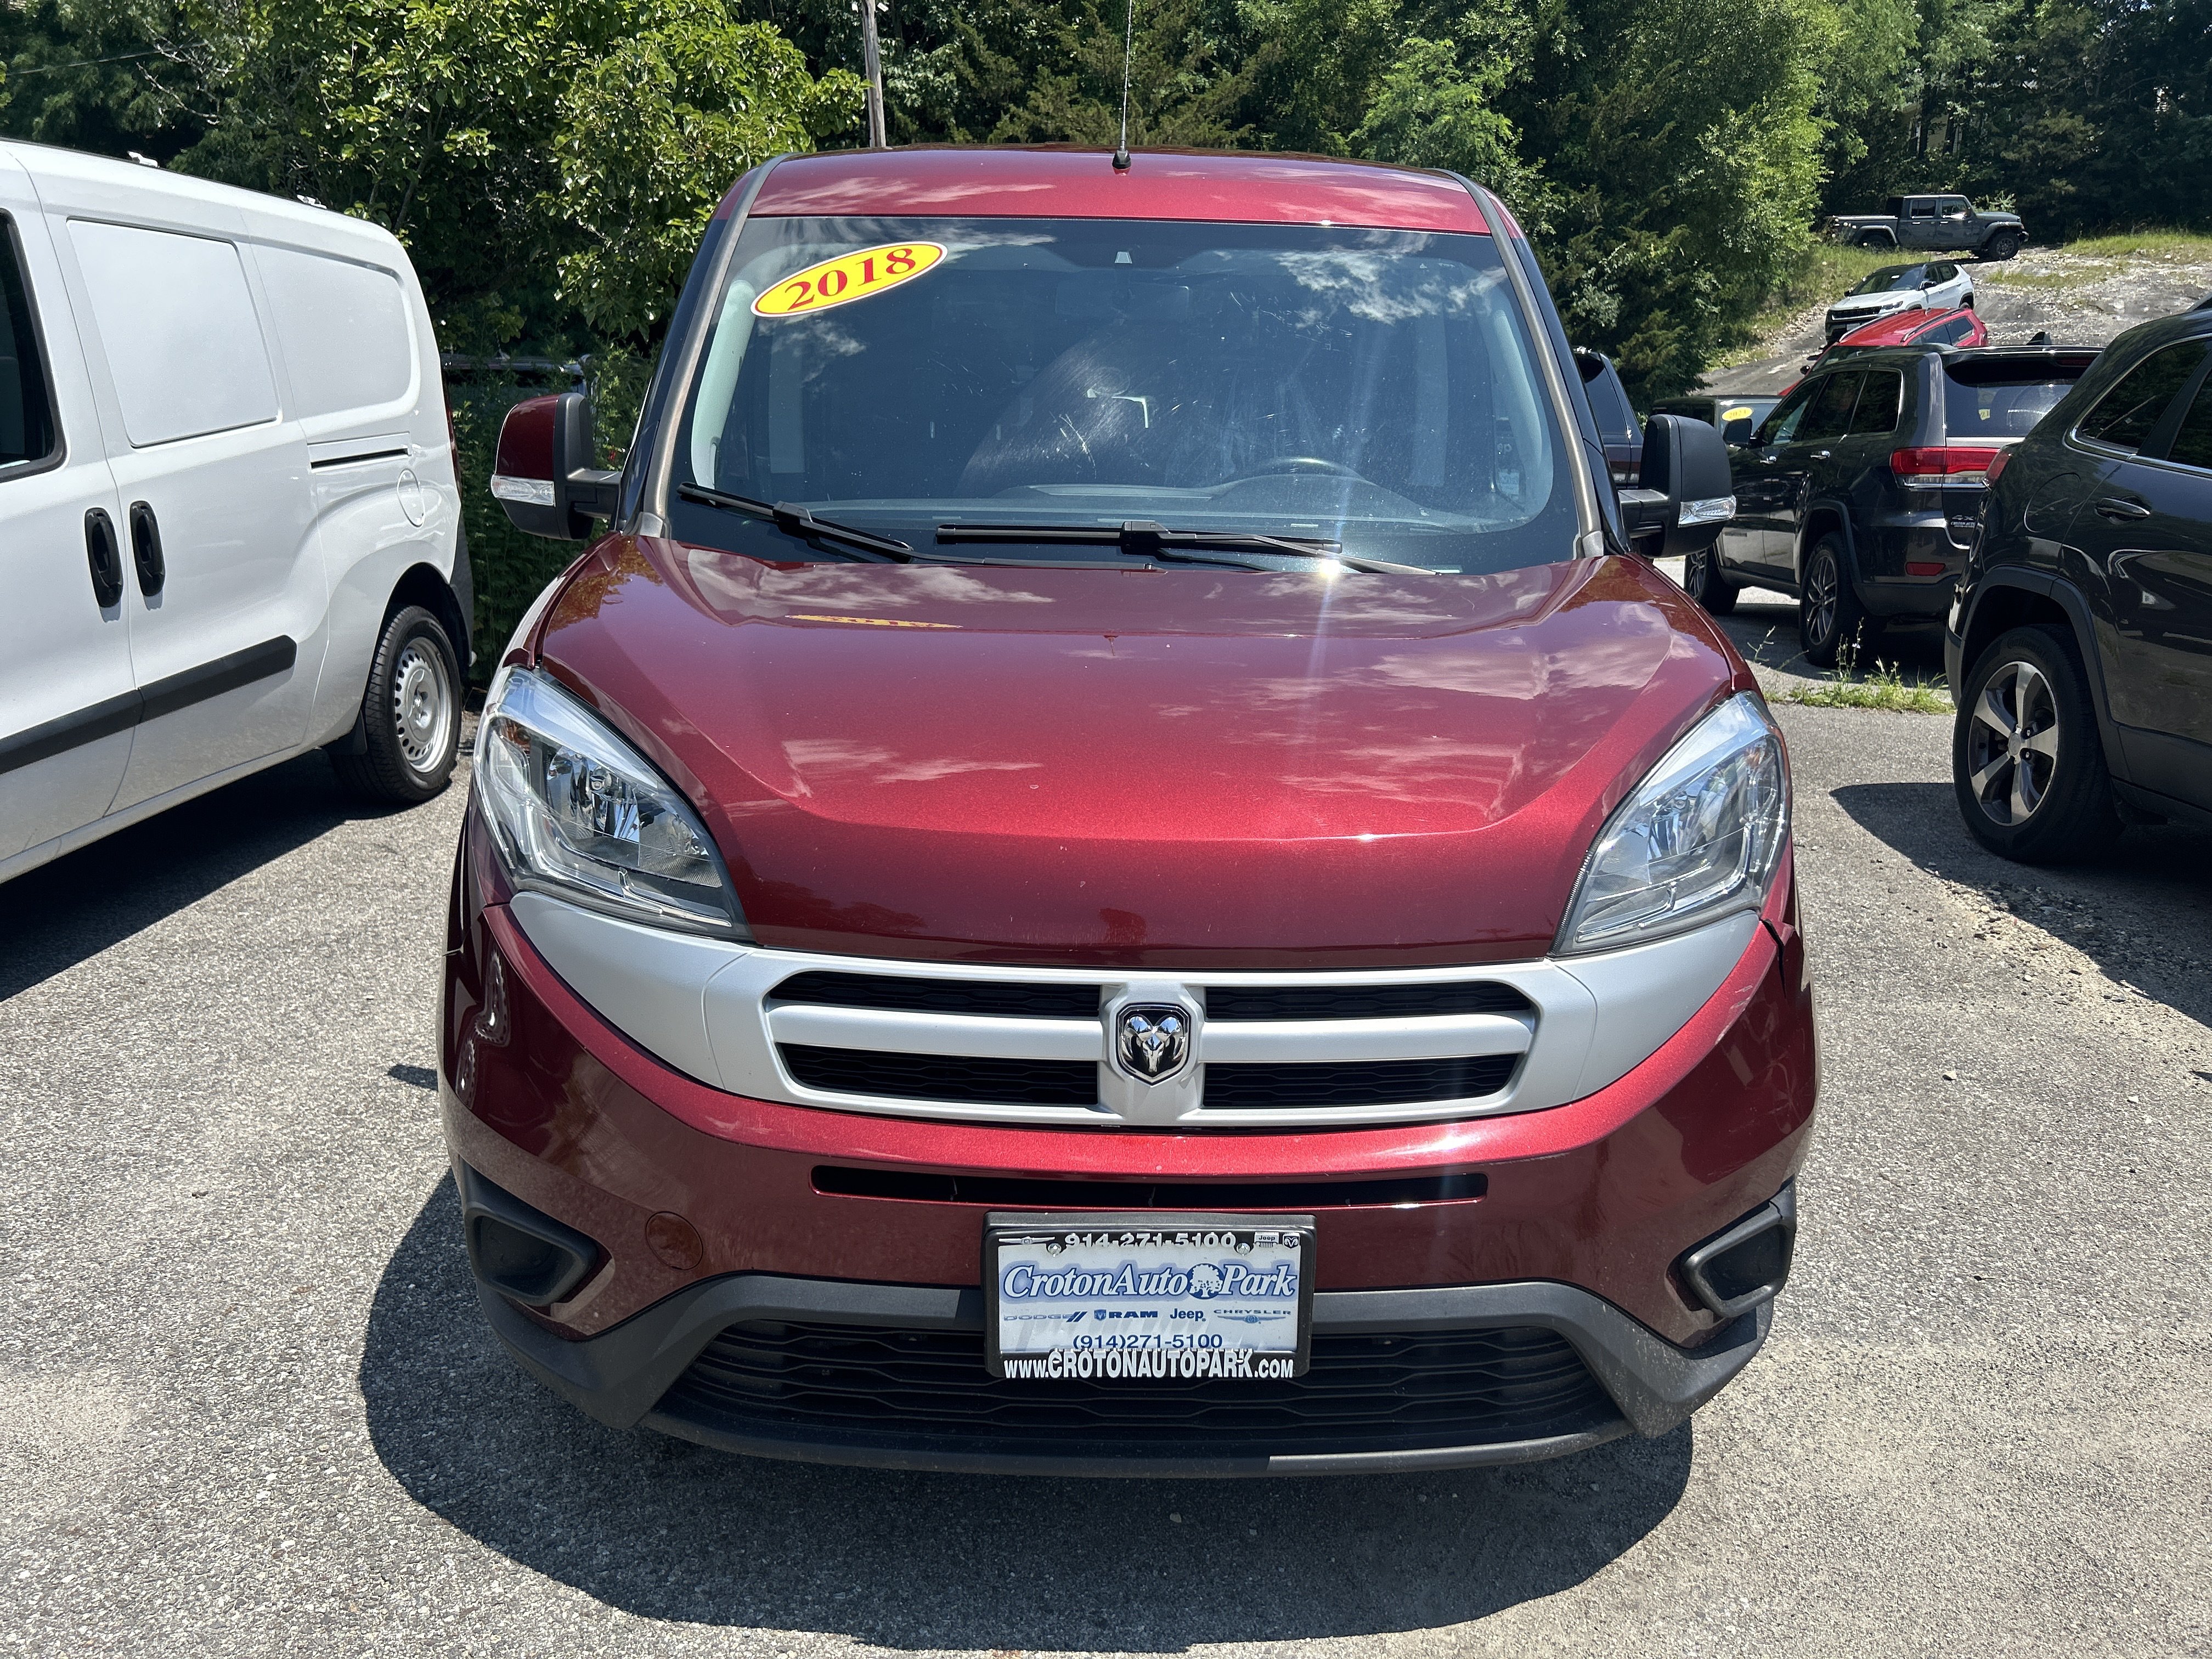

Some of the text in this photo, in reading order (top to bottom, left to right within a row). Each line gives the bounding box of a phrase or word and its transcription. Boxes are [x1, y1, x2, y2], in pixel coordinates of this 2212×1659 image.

[785, 248, 916, 311] 2018
[1065, 1232, 1236, 1248] 914-271-5100
[1219, 1265, 1297, 1297] Park
[1109, 1311, 1158, 1319] RAM
[1170, 1308, 1204, 1322] Jeep
[1073, 1334, 1223, 1350] (914)271-5100
